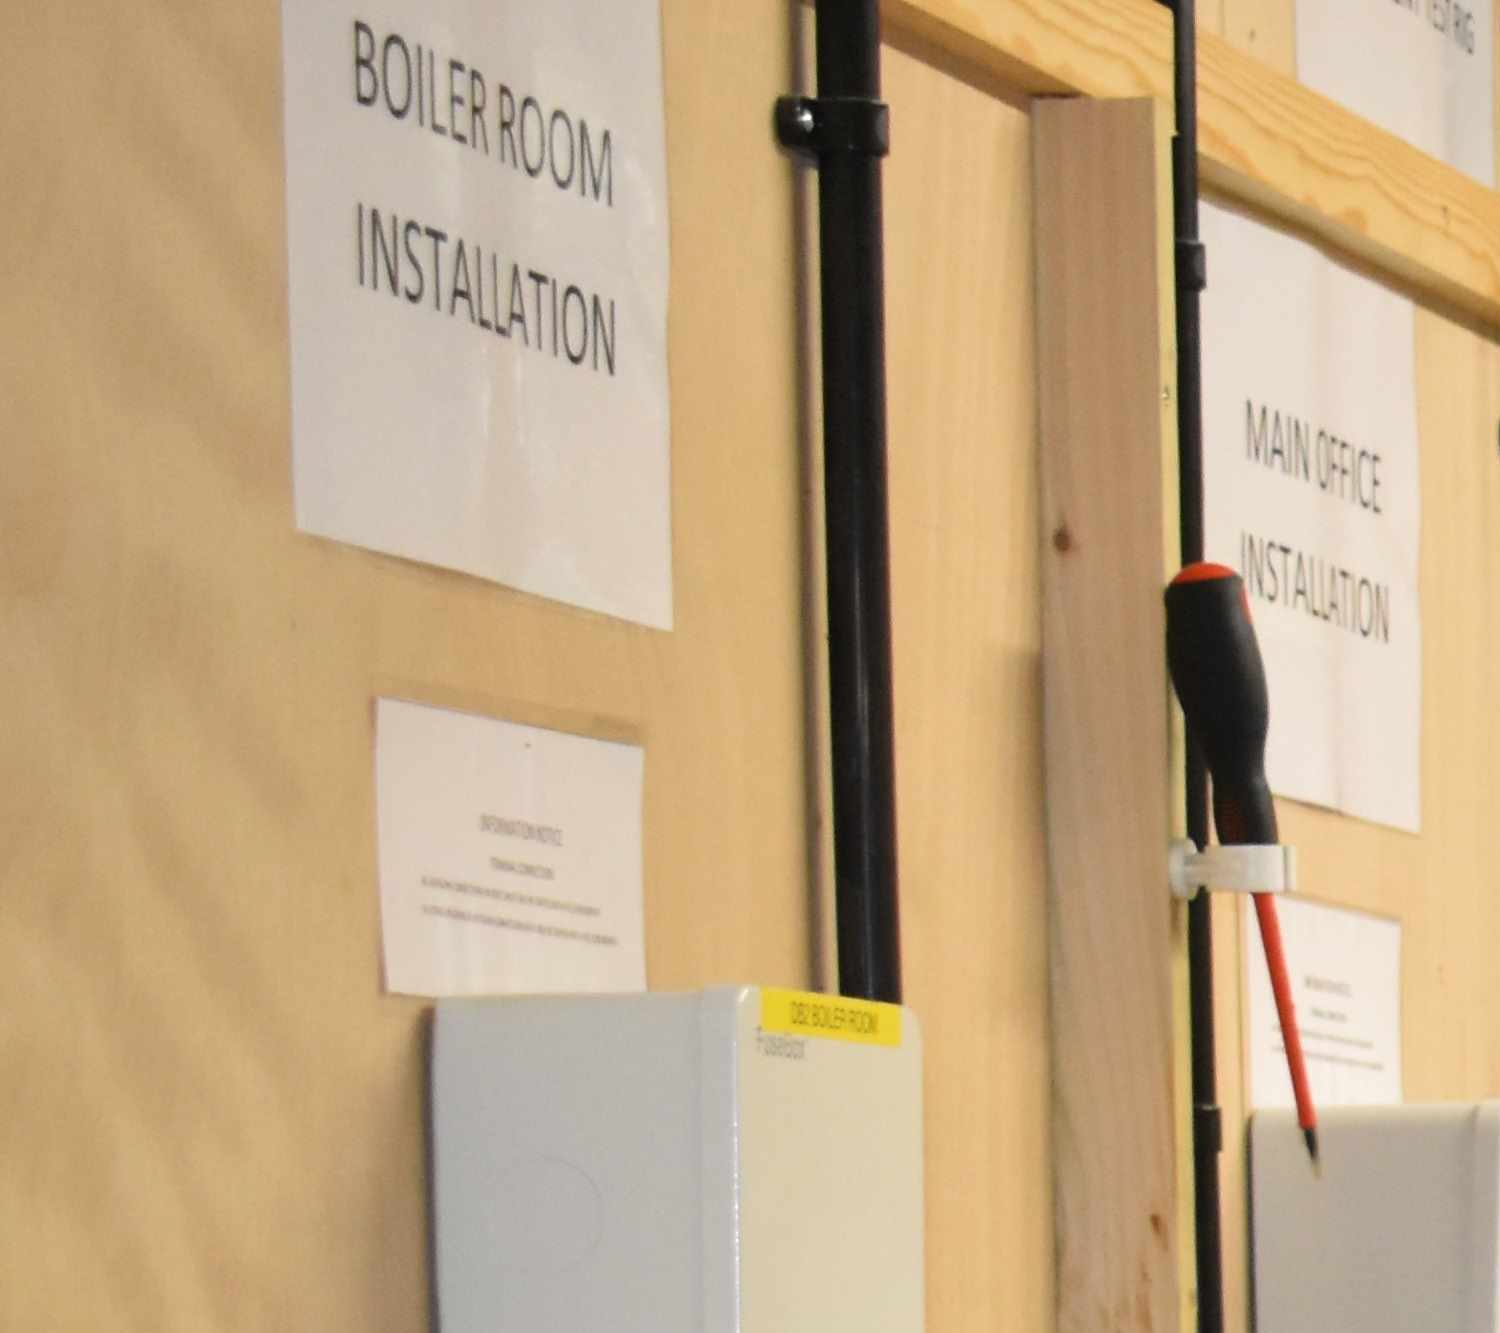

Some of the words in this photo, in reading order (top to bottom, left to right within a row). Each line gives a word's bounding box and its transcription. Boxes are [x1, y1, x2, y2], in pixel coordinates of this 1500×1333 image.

[355, 20, 489, 155] BOILER
[499, 83, 613, 207] ROOM
[358, 203, 615, 375] INSTALLATION
[1246, 400, 1310, 482] MAIN
[1316, 429, 1382, 514] OFFICE
[1240, 530, 1389, 643] INSTALLATION
